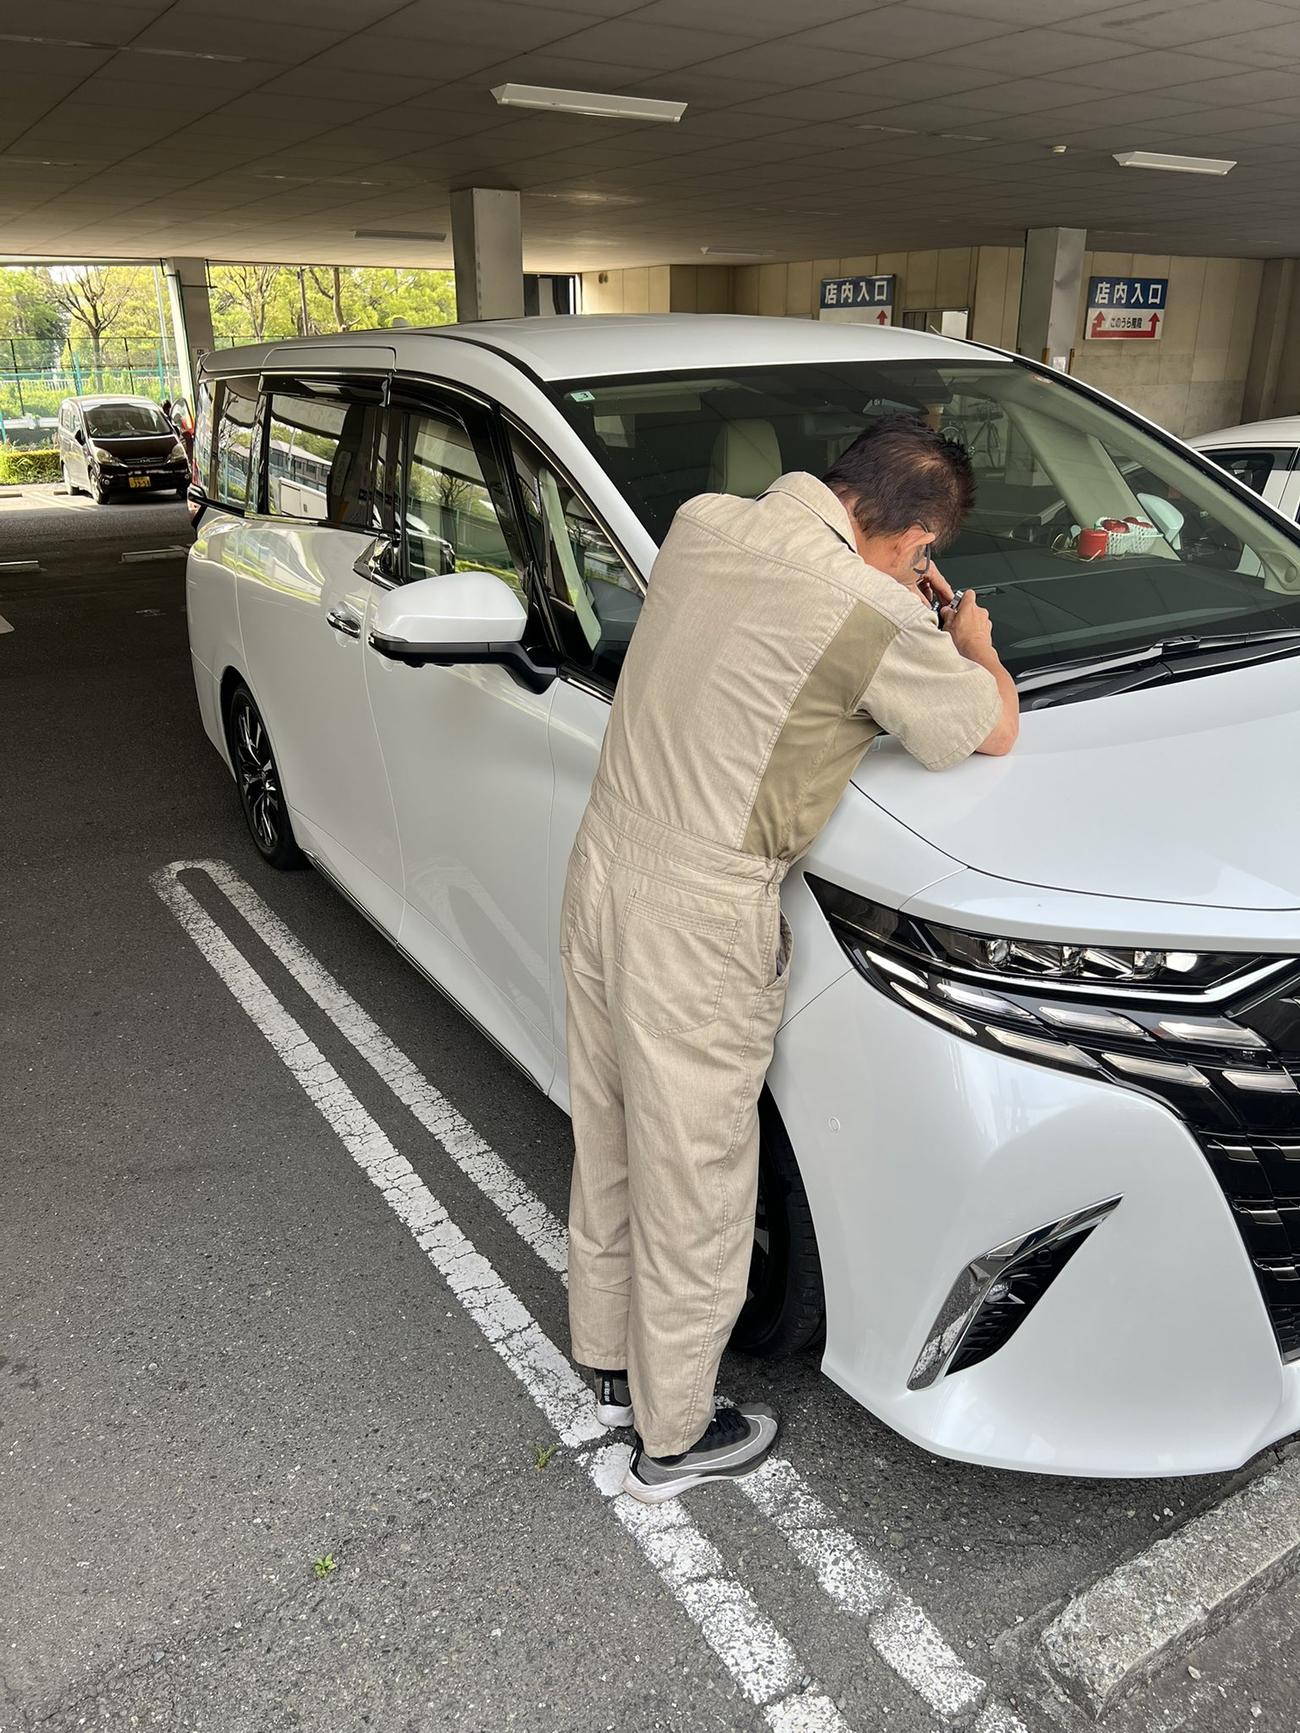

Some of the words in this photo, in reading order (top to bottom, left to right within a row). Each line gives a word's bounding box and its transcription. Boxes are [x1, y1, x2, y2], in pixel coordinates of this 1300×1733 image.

[825, 281, 887, 304] 店内入口
[1095, 281, 1162, 304] 店内入口
